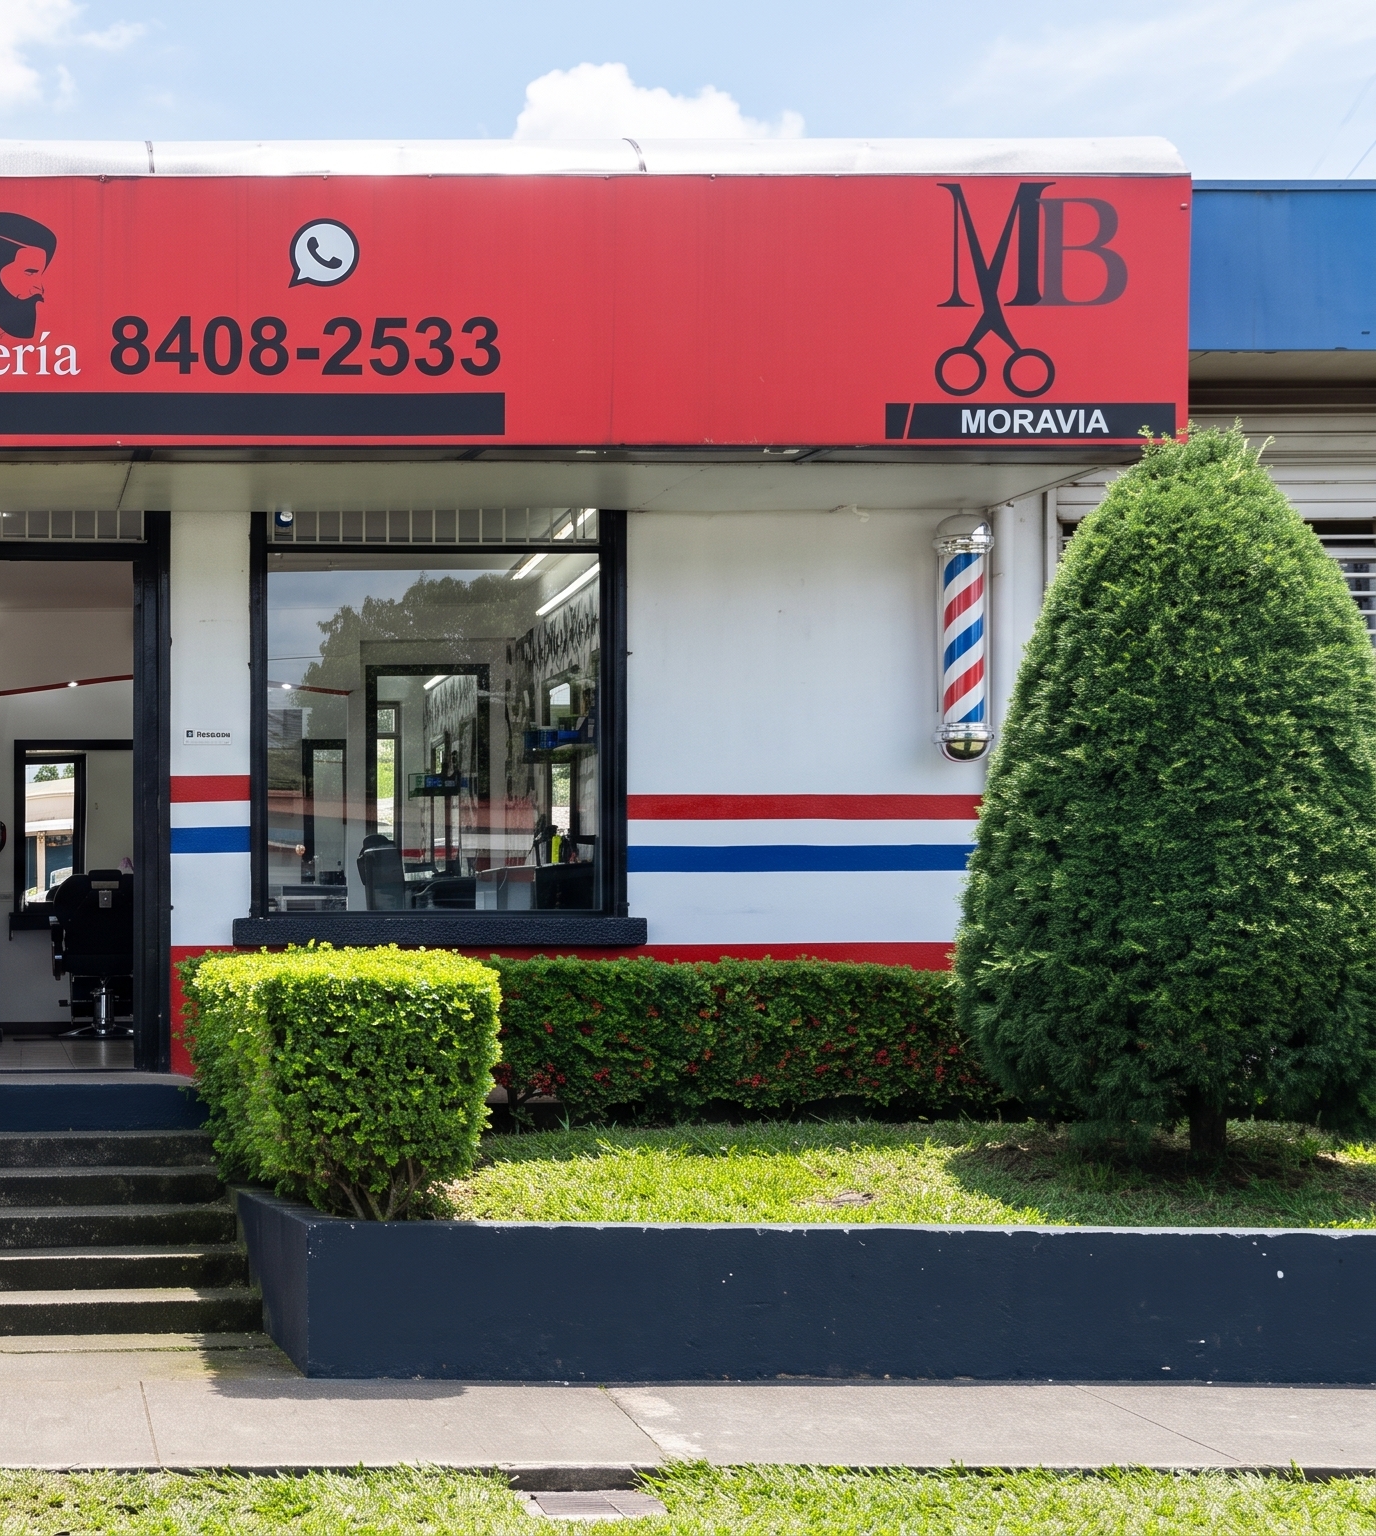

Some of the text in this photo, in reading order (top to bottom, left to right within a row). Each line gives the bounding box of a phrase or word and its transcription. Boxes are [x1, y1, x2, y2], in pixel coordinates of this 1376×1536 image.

[936, 181, 1129, 307] MB
[110, 315, 502, 377] 8408-2533
[960, 409, 1110, 434] MORAVIA
